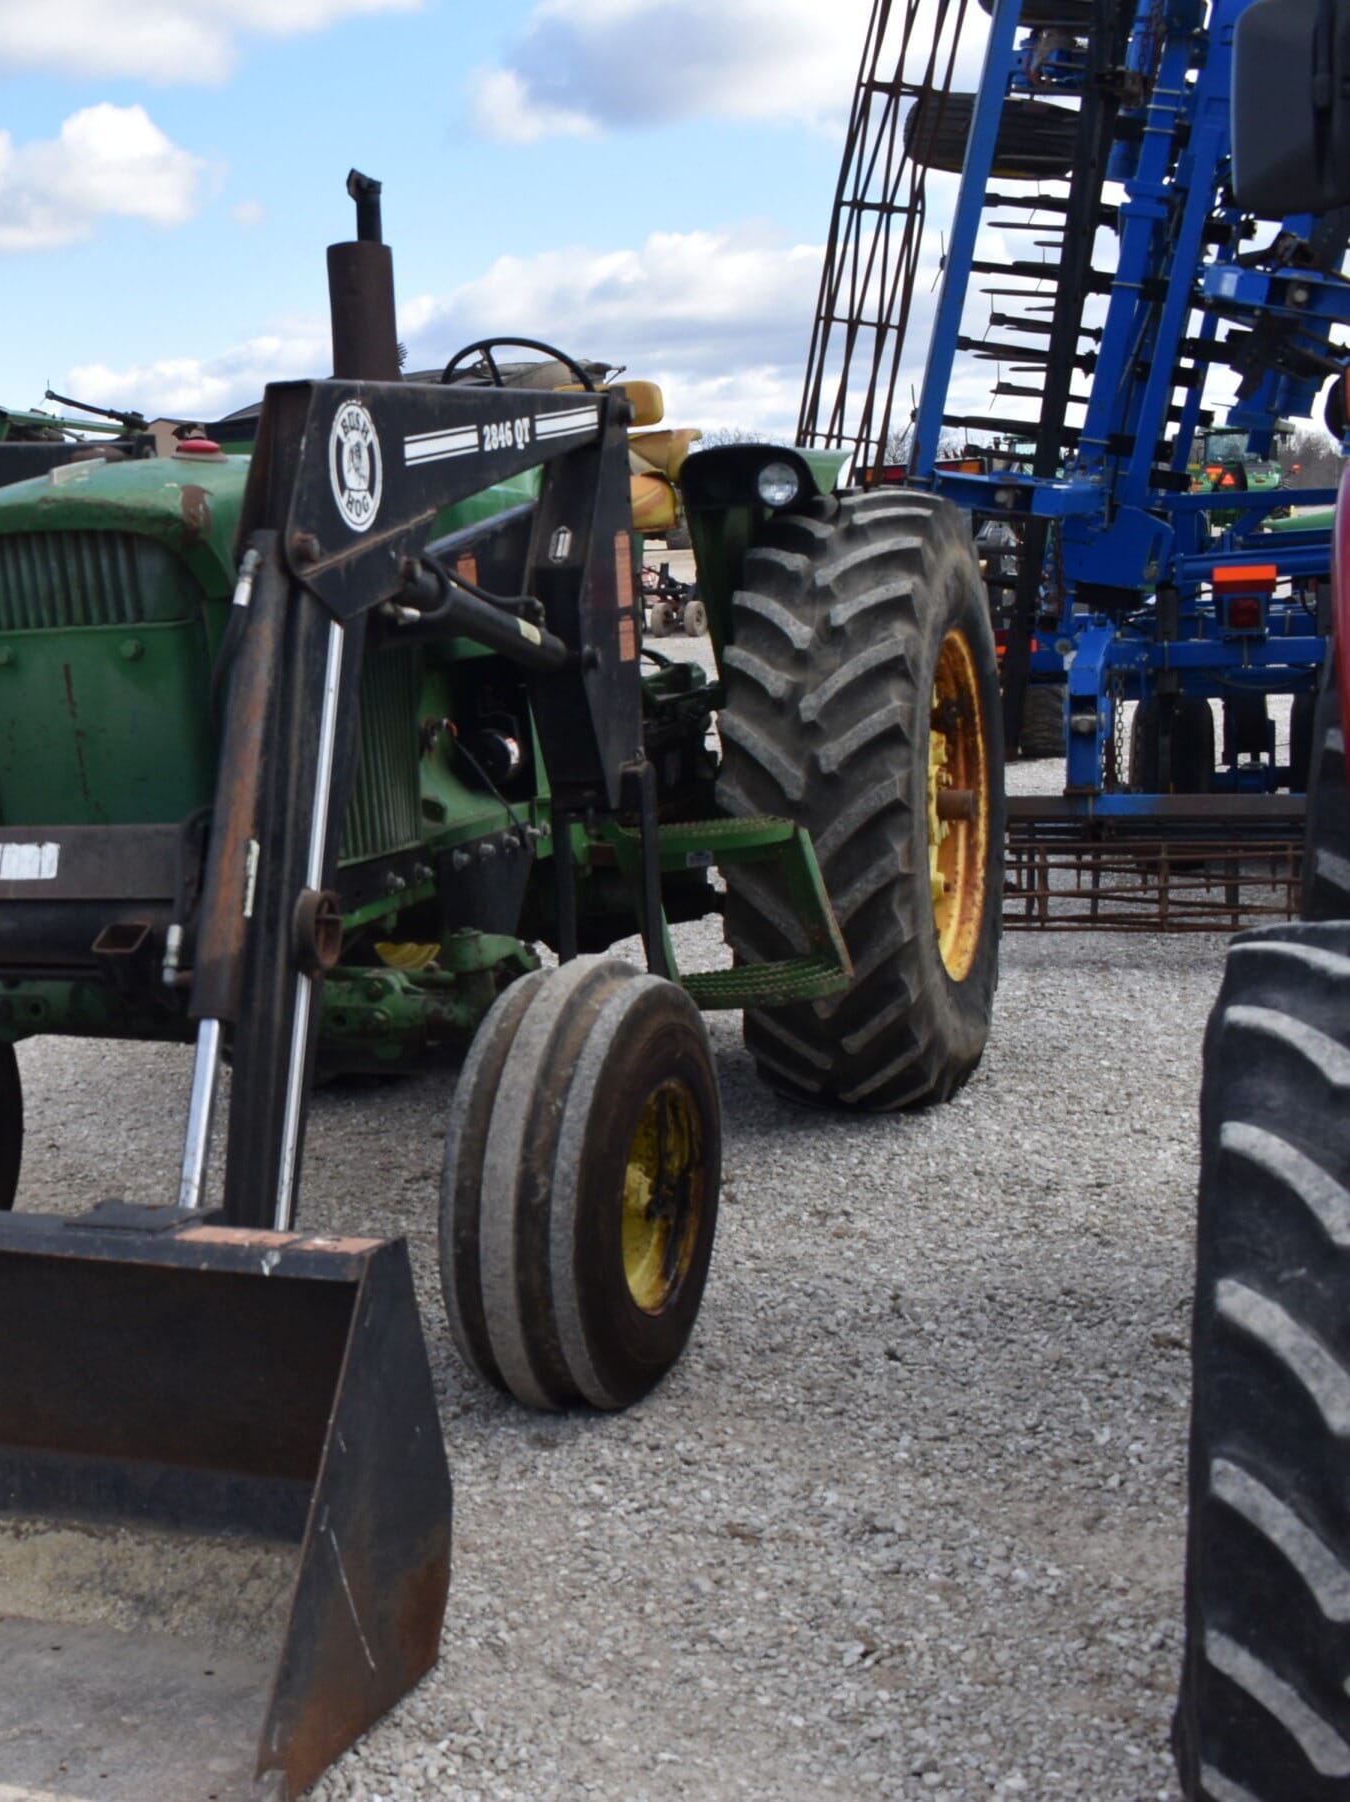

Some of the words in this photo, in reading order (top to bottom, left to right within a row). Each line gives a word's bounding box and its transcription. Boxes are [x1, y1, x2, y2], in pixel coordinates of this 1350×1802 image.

[340, 410, 370, 440] BUSH
[482, 420, 514, 452] 2846
[514, 416, 531, 451] QT
[345, 492, 371, 518] HOG
